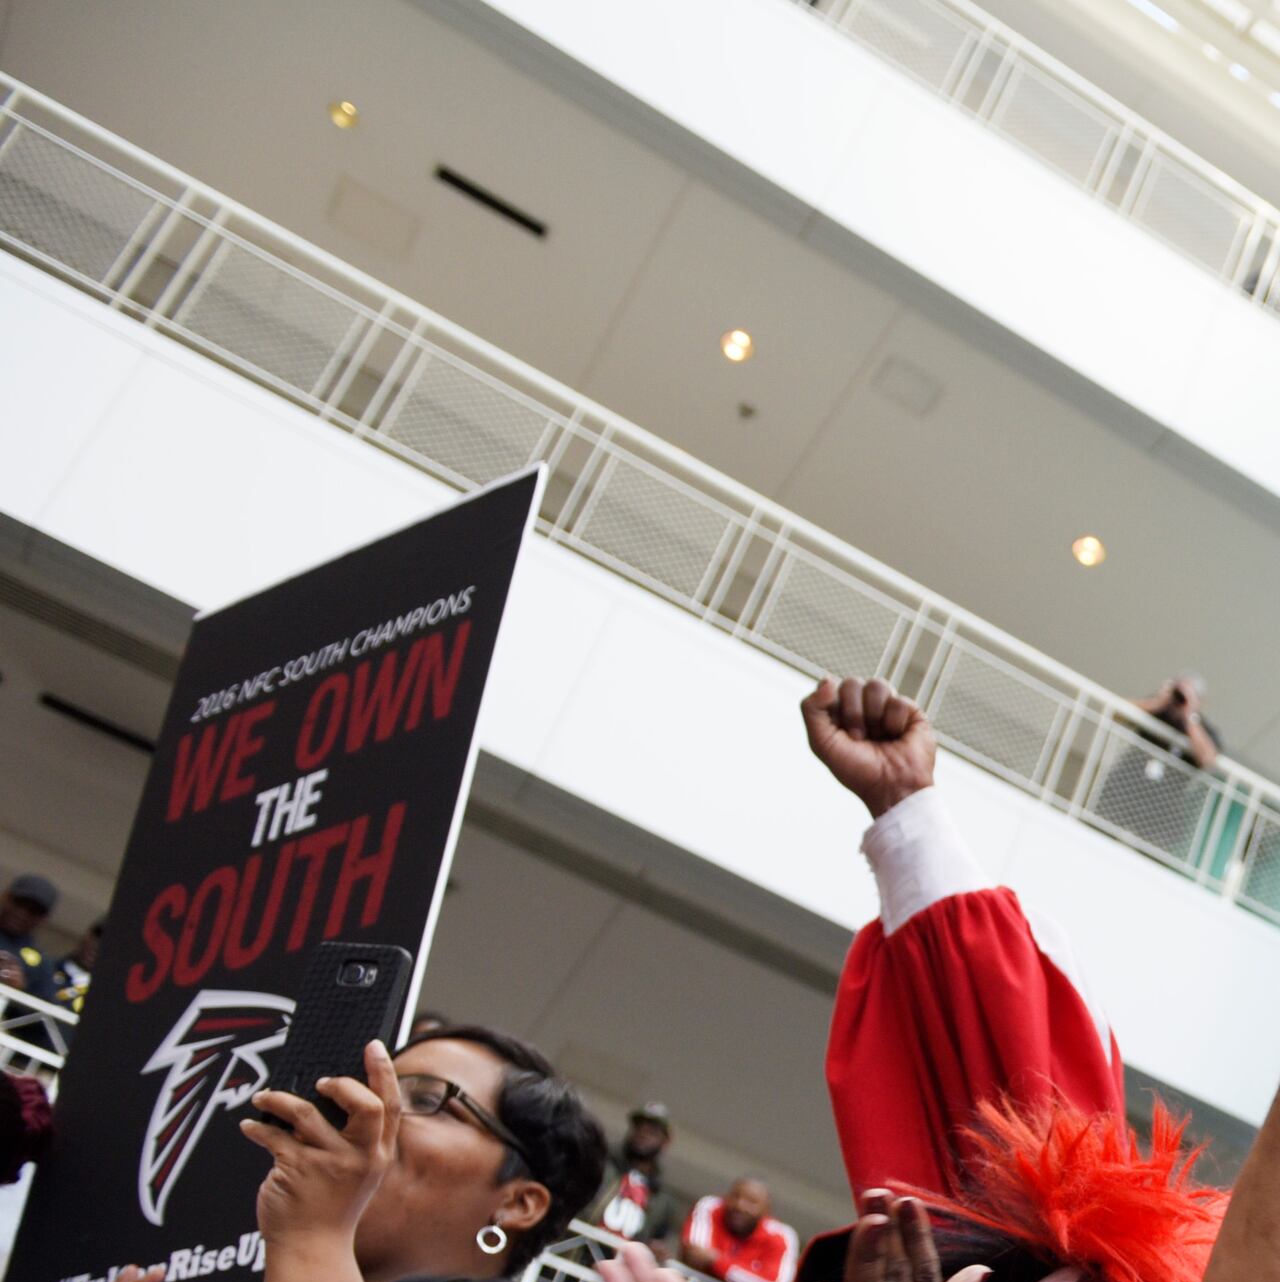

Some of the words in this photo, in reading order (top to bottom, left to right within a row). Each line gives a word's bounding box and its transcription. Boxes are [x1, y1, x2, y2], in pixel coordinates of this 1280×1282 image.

[166, 700, 276, 823] WE
[295, 619, 473, 770] OWN
[190, 684, 240, 723] 2016
[237, 667, 282, 703] NFC
[278, 638, 352, 687] SOUTH
[350, 585, 477, 657] CHAMPIONS
[250, 768, 329, 848] THE
[125, 802, 407, 1003] SOUTH
